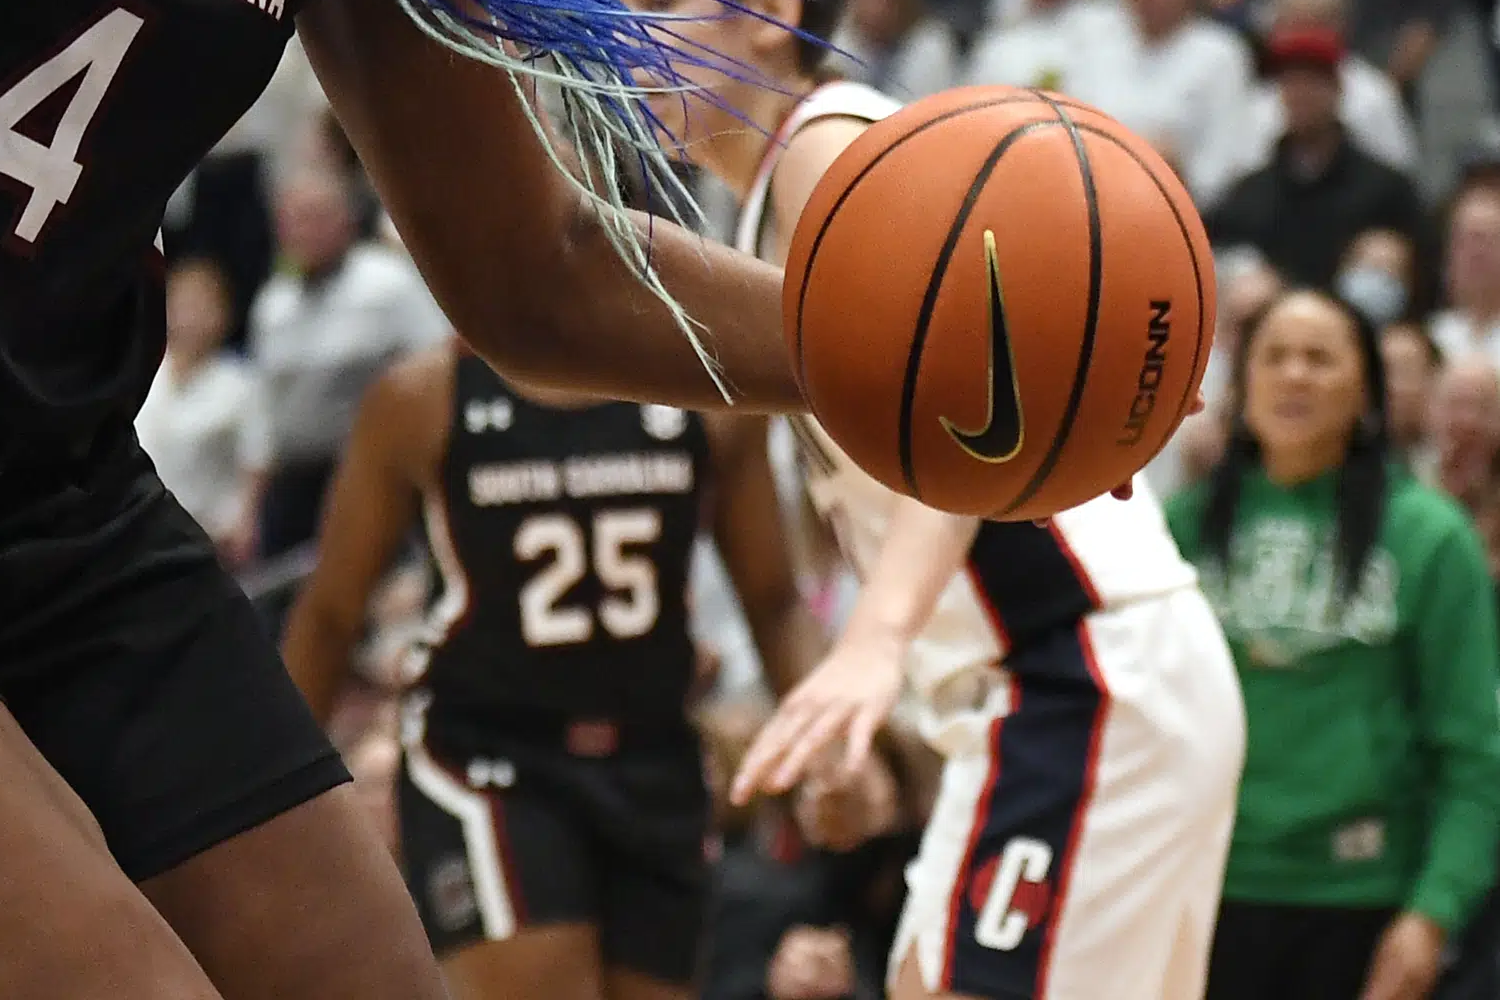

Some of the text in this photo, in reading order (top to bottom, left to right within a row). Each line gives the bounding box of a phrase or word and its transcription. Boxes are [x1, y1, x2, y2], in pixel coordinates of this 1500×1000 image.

[1116, 298, 1172, 449] UCONN
[512, 506, 663, 650] 25
[973, 835, 1054, 952] C
